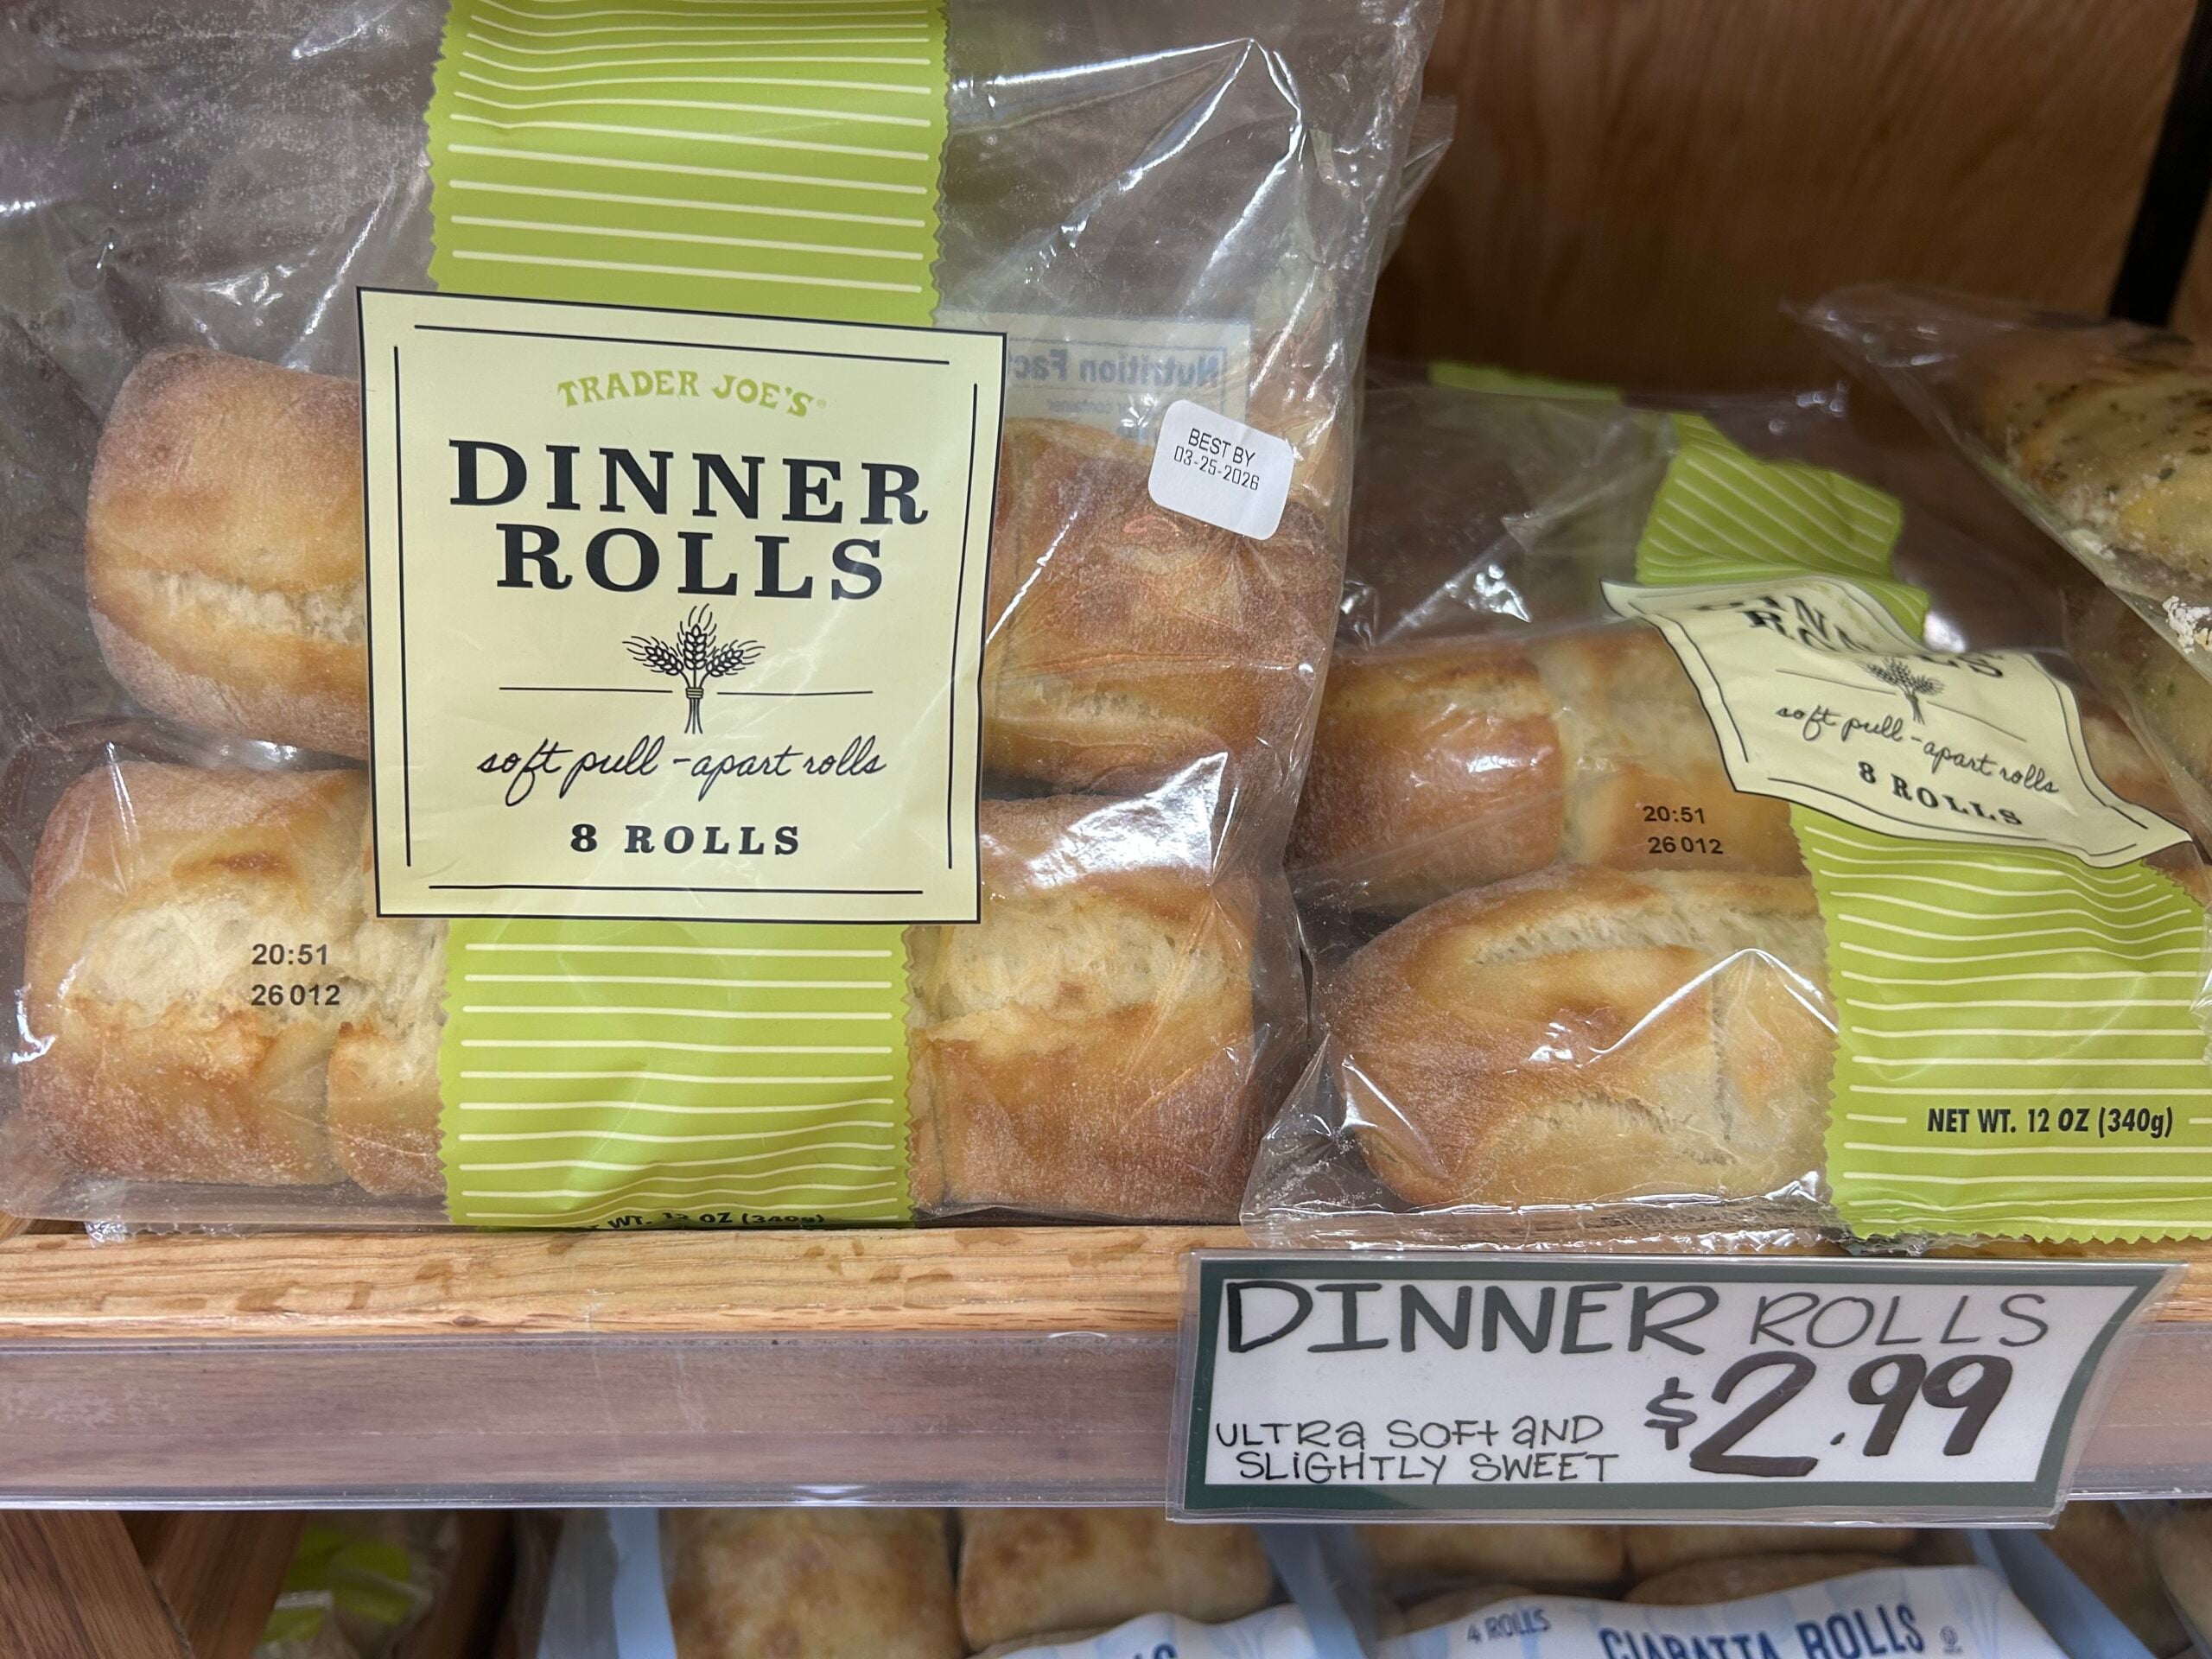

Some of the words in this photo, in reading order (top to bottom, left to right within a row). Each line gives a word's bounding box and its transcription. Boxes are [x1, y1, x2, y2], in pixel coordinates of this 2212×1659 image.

[557, 370, 700, 407] TRADER
[711, 374, 815, 416] JOE'S
[1174, 445, 1260, 491] 03-25-2026
[1188, 428, 1231, 459] BEST
[1232, 446, 1255, 467] BY
[448, 438, 930, 524] DINNER
[496, 522, 884, 601] ROLLS
[477, 738, 574, 807] soft
[803, 735, 887, 776] rolls
[1775, 704, 1837, 741] soft
[1999, 763, 2060, 794] rolls
[1643, 805, 1705, 824] 20:51
[1858, 760, 1877, 785] 8
[1891, 772, 2023, 826] ROLLS
[570, 823, 598, 852] 8
[624, 824, 799, 855] ROLLS
[251, 944, 327, 965] 20:51
[1927, 1108, 1970, 1133] NET
[1977, 1109, 2017, 1134] WT.
[2028, 1107, 2050, 1133] 12
[2057, 1107, 2090, 1133] OZ
[2097, 1106, 2174, 1139] (340g)
[607, 1214, 652, 1230] WT.
[698, 1211, 734, 1224] OZ
[1226, 1280, 1719, 1356] DINNER
[1749, 1291, 2050, 1349] ROLLS
[1643, 1350, 2014, 1478] $2.99
[1470, 1450, 1620, 1484] SWEET
[1467, 1624, 1482, 1643] 4
[1484, 1607, 1552, 1641] ROLLS
[1795, 1603, 1927, 1659] ROLLS
